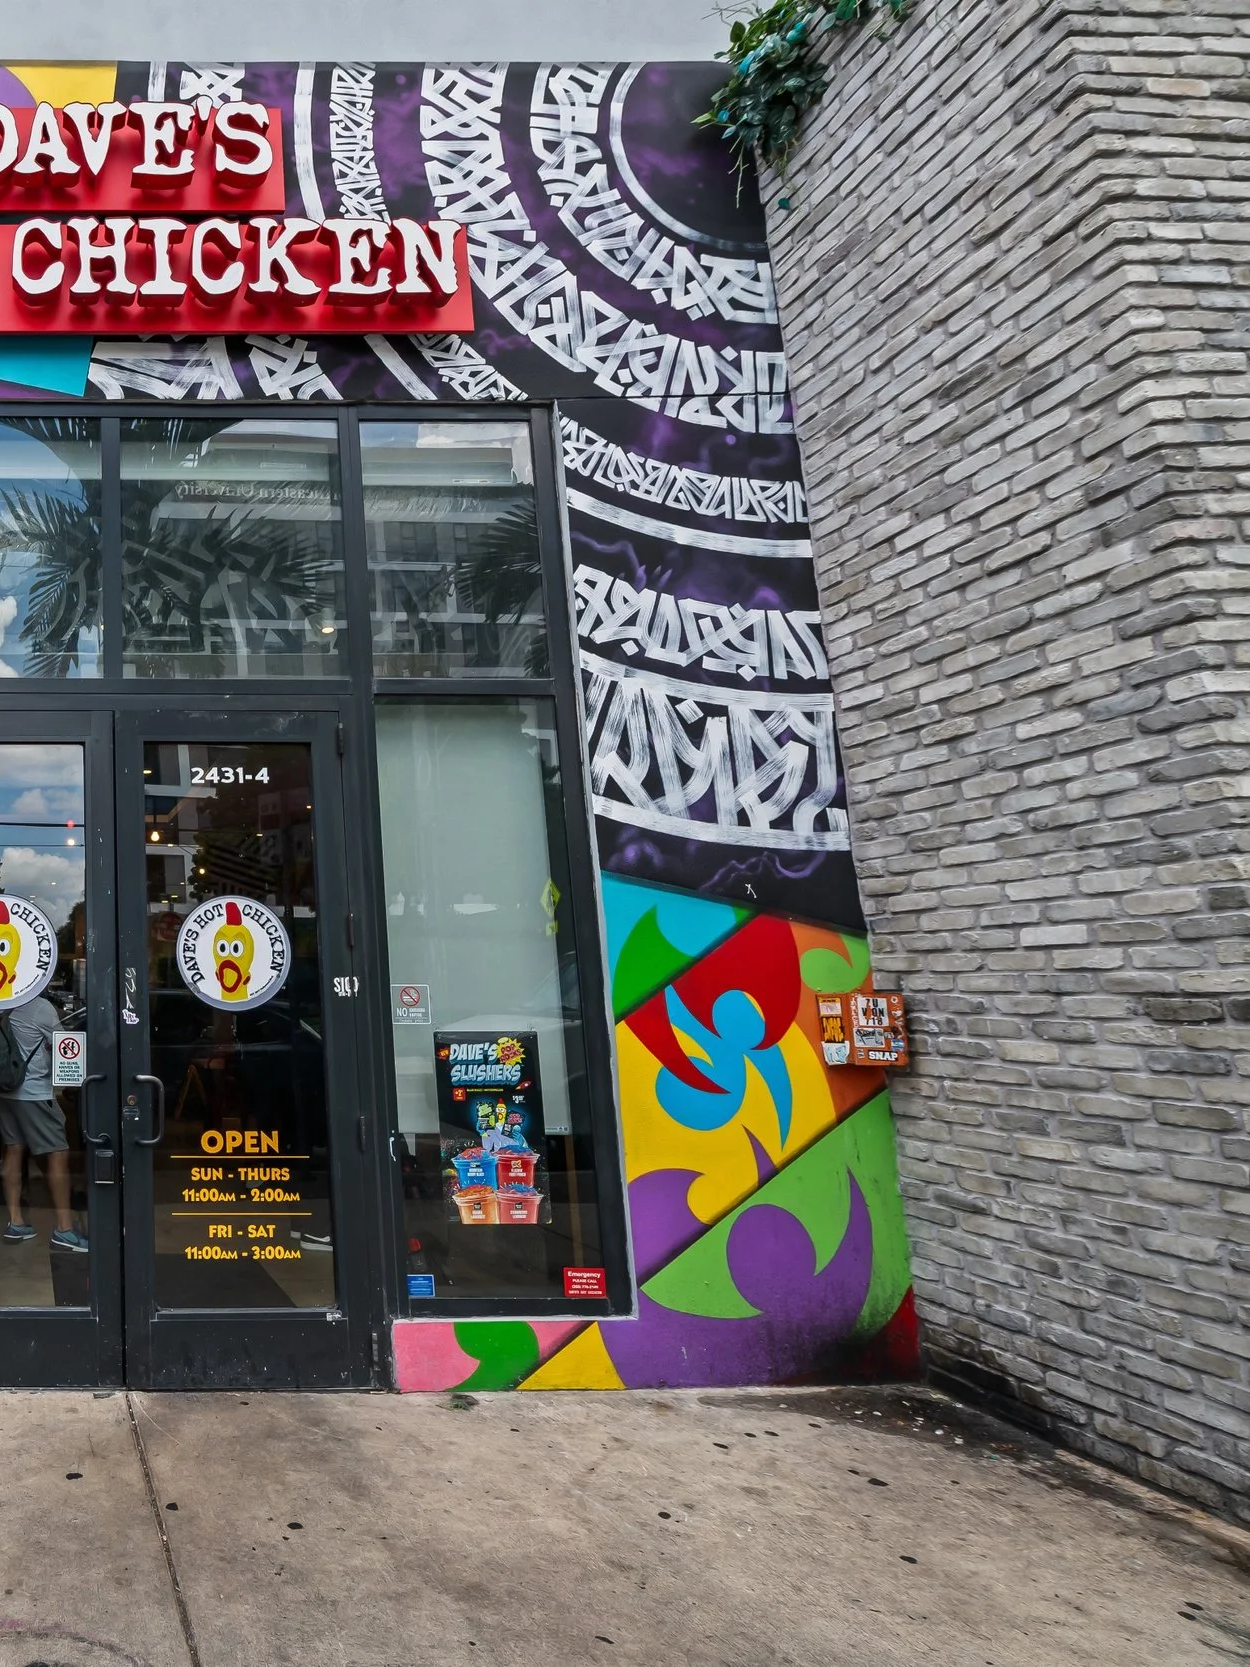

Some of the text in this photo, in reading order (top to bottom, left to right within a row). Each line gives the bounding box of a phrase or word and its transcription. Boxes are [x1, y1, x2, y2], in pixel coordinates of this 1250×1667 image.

[11, 217, 459, 302] CHICKEN
[191, 767, 270, 784] 2431-4
[10, 902, 52, 972] CHICKEN
[182, 904, 285, 986] DAVE'S HOT CHICKEN
[396, 1008, 408, 1016] NO
[449, 1042, 516, 1063] DAVE'S POP
[868, 1051, 898, 1060] SNAP
[450, 1064, 522, 1083] SLUSHERS
[200, 1130, 279, 1154] OPEN
[190, 1168, 223, 1181] SUN
[238, 1168, 290, 1181] THURS
[182, 1188, 236, 1202] 11:00AM
[250, 1188, 300, 1202] 2:00AM
[208, 1224, 232, 1238] FRI
[248, 1224, 276, 1238] SAT
[184, 1246, 238, 1260] 11:00AM
[252, 1246, 301, 1260] 3:00AM
